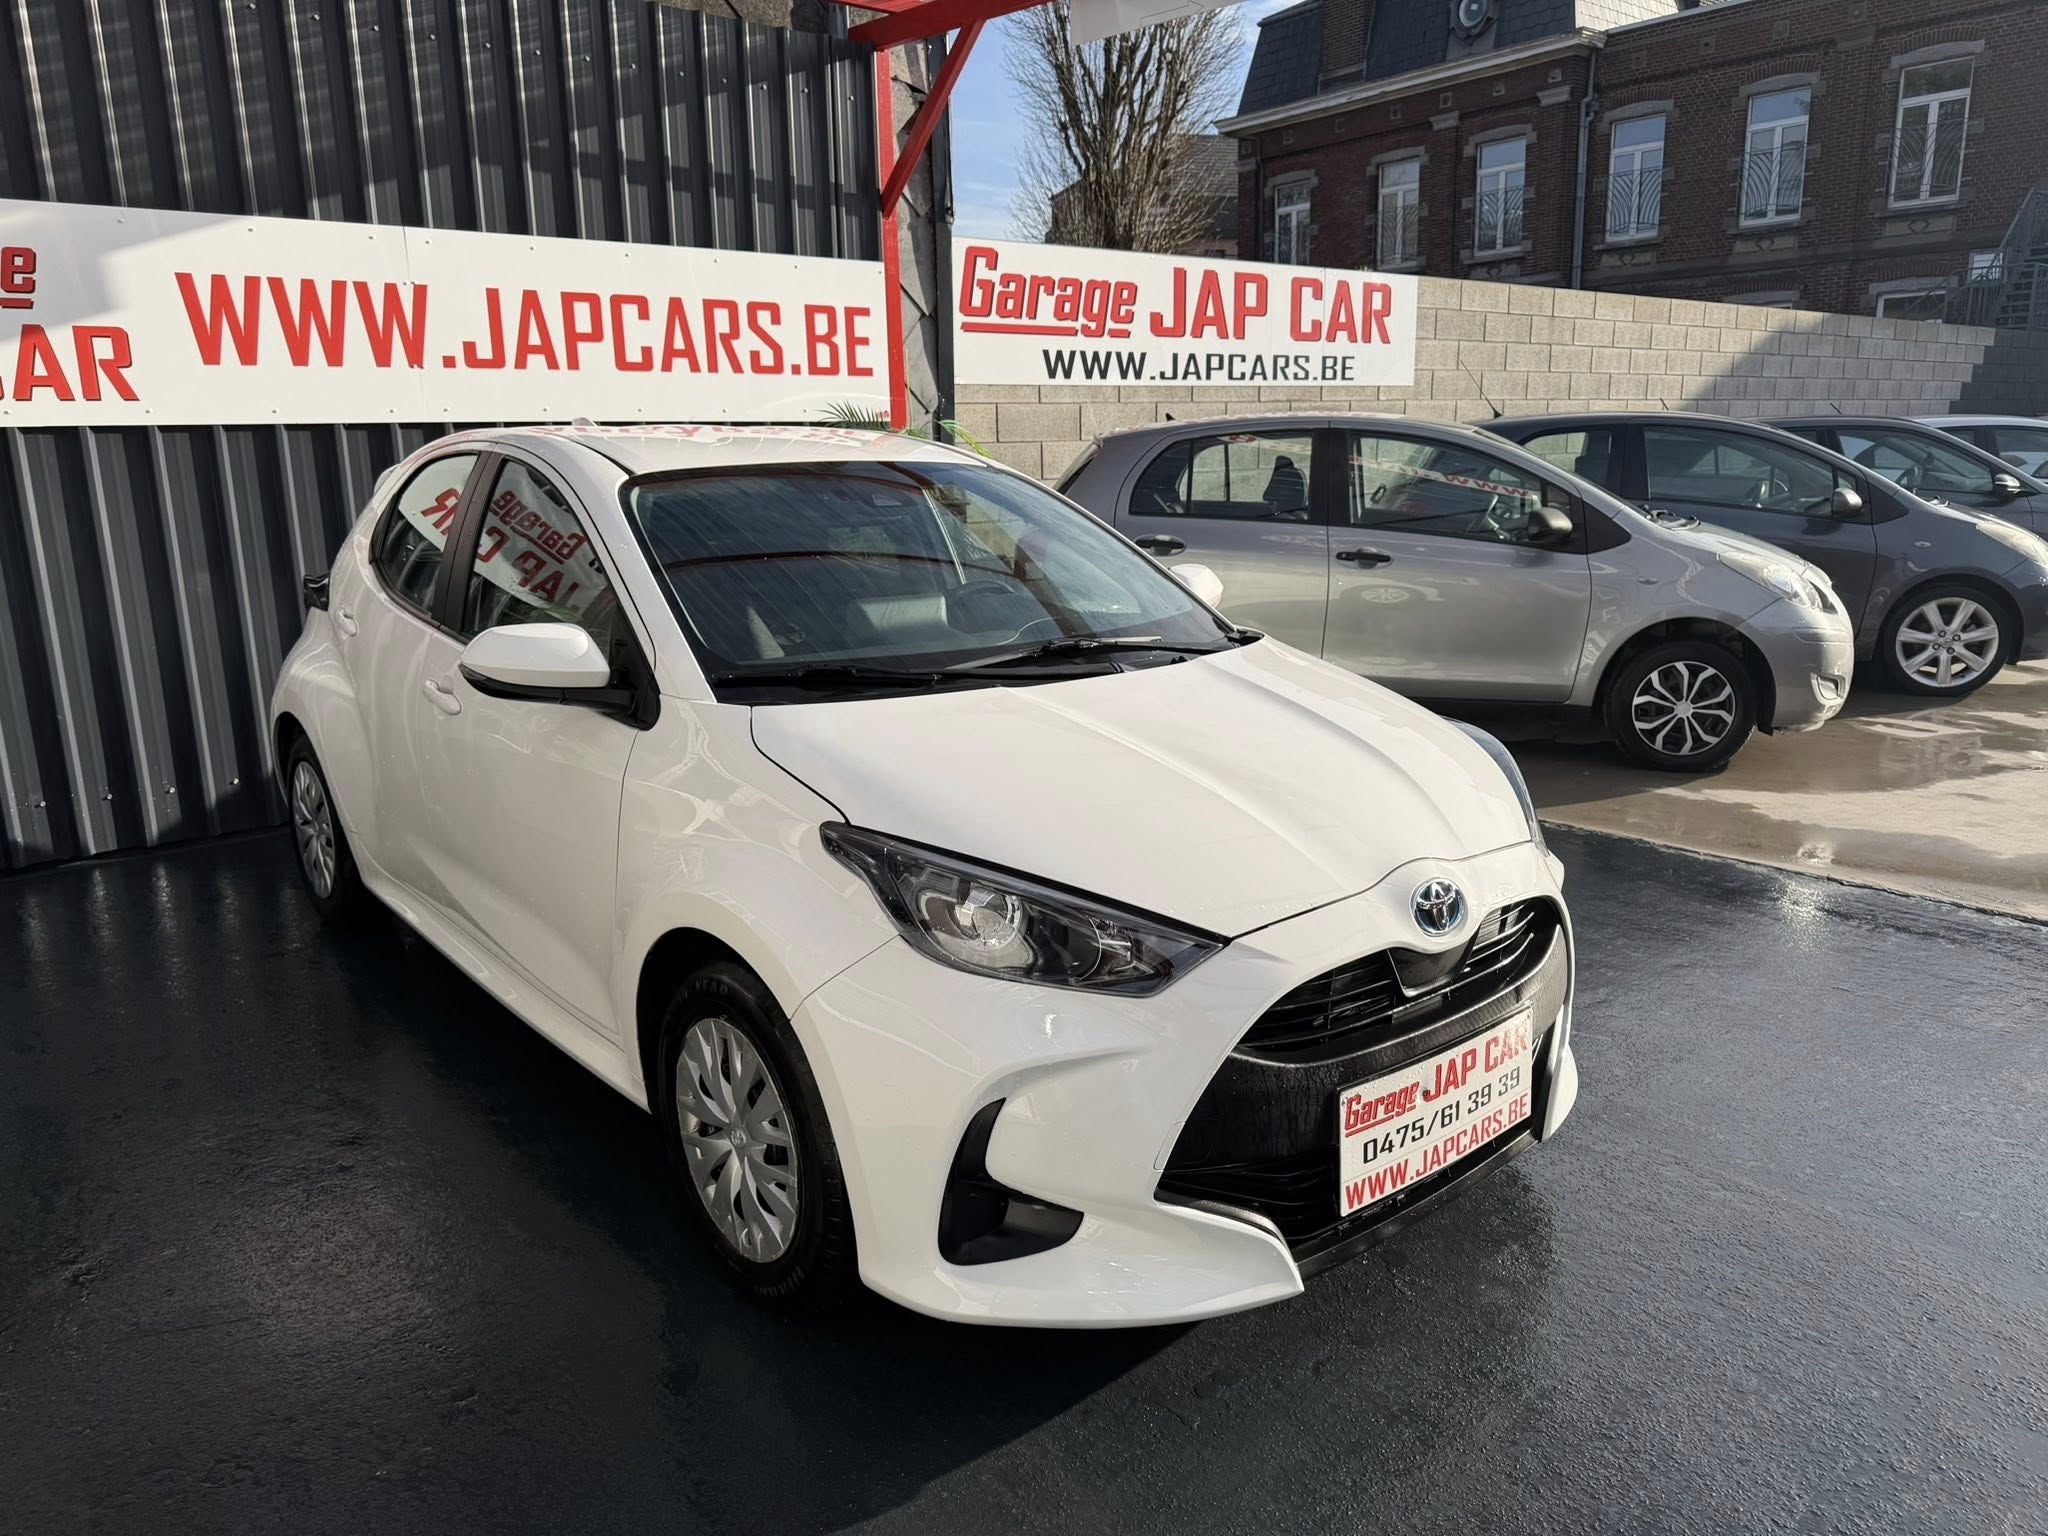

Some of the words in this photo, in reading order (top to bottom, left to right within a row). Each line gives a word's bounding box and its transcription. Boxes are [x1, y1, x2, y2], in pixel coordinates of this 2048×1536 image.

[174, 271, 874, 378] WWW.JAPCARS.BE
[958, 245, 1138, 338] Garage
[1150, 267, 1268, 340] JAP
[1290, 276, 1392, 345] CAR
[0, 323, 140, 402] AR
[1042, 348, 1355, 381] WWW.JAPCARS.BE
[1344, 1081, 1420, 1131] Garage
[1422, 1047, 1477, 1102] JAP
[1485, 1022, 1528, 1073] CAR
[1363, 1100, 1460, 1164] 0475/61
[1467, 1083, 1492, 1114] 39
[1498, 1066, 1520, 1096] 39
[1345, 1093, 1528, 1210] WWW.JAPCARS.BE
